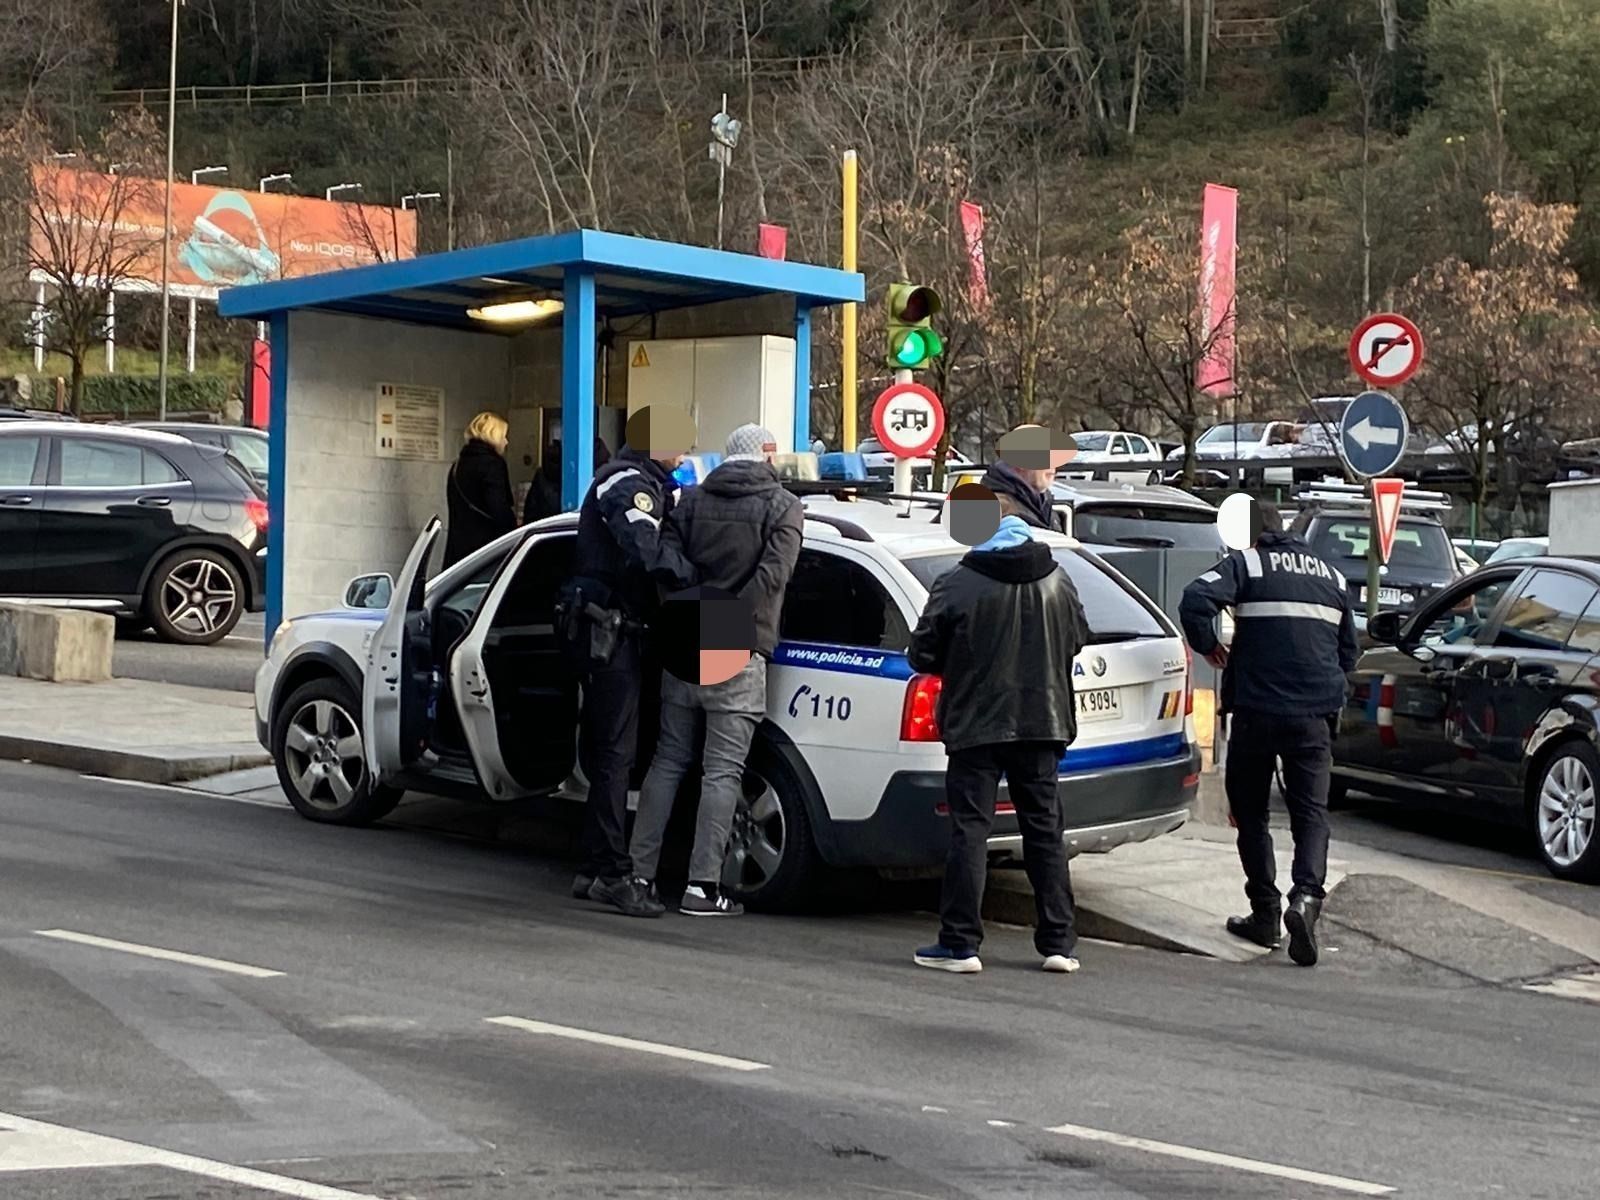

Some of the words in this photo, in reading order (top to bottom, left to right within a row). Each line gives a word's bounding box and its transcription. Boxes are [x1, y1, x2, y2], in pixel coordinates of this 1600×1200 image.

[314, 242, 355, 257] IQOS
[1268, 552, 1332, 580] POLICIA
[786, 649, 884, 668] www.policia.ad
[811, 694, 851, 720] 110
[1089, 690, 1117, 711] 9094
